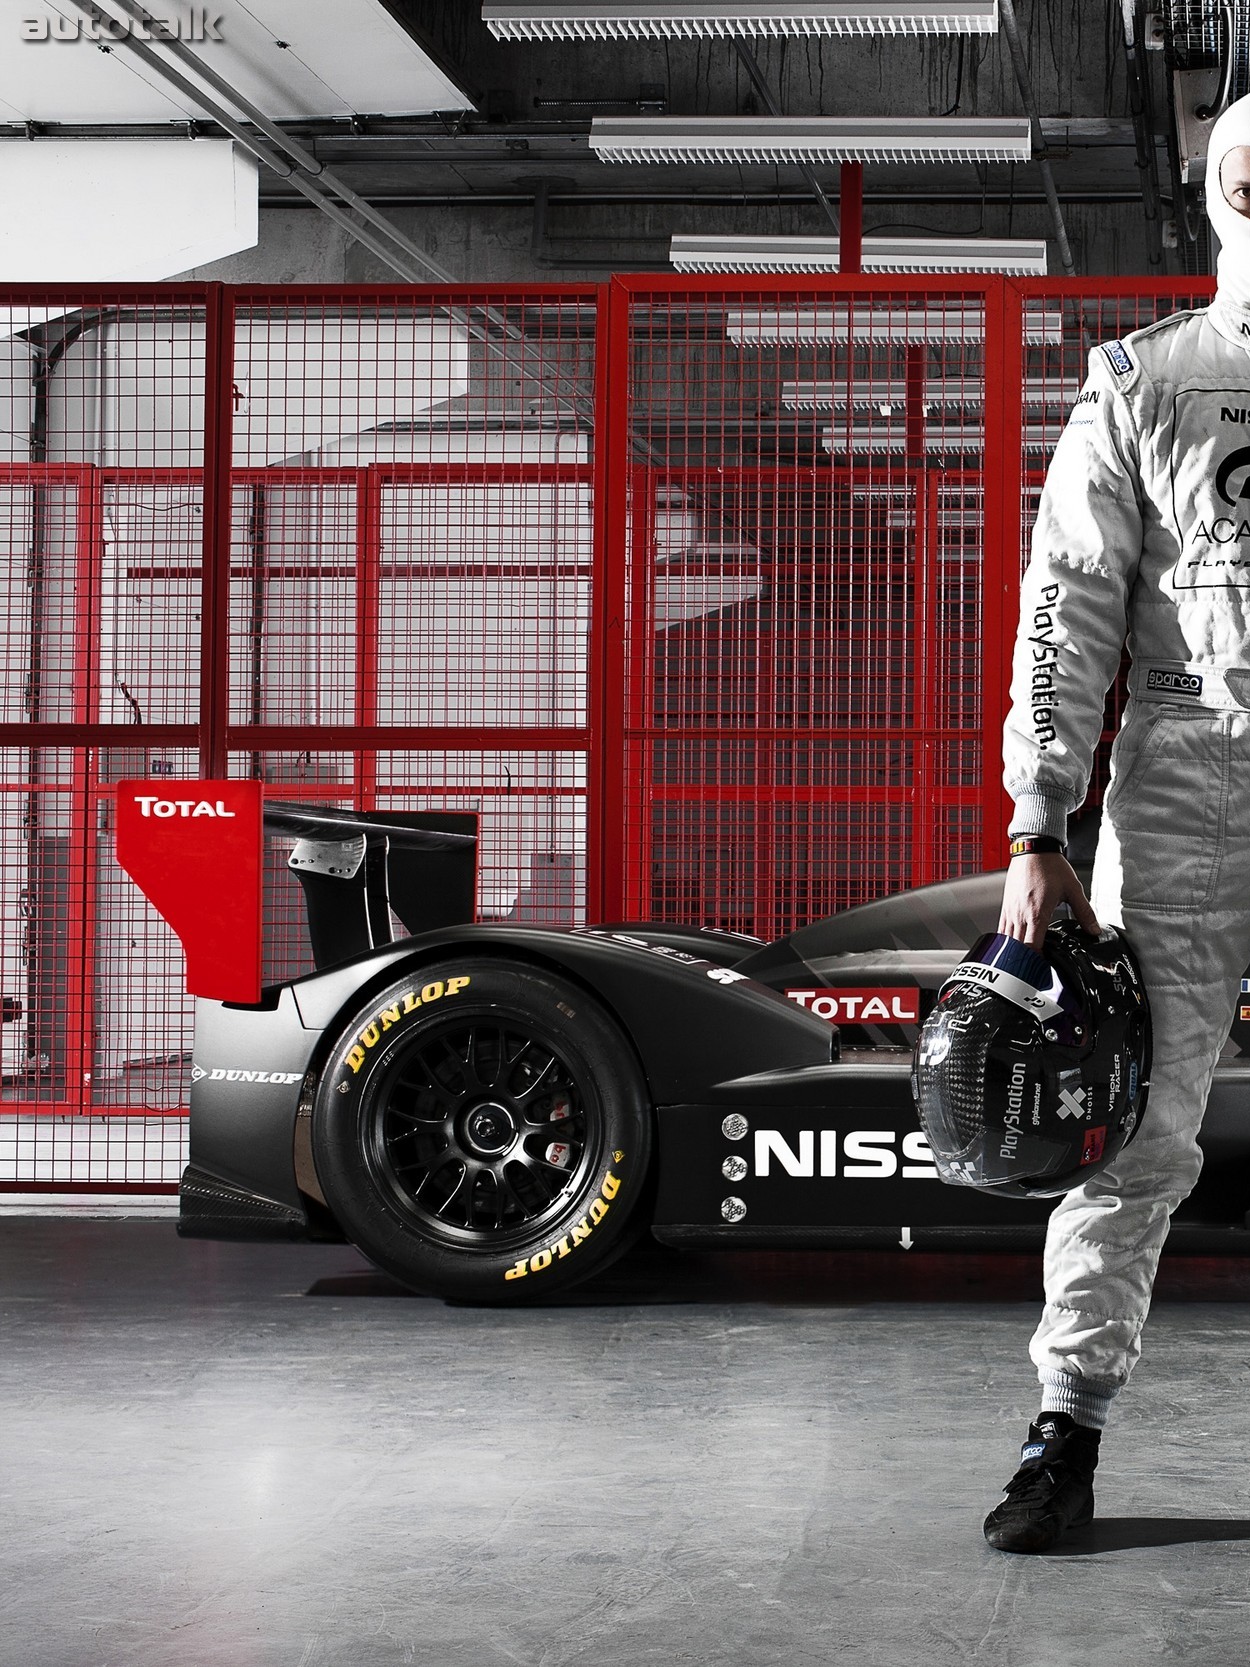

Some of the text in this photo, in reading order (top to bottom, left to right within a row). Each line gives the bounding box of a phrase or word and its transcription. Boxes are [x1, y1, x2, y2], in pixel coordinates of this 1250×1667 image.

[1148, 671, 1200, 689] sparco
[134, 796, 236, 818] TOTAL
[787, 991, 915, 1020] TOTAL
[344, 976, 471, 1074] DUNLOP
[207, 1069, 304, 1085] DUNLOP
[1108, 1073, 1116, 1112] VISION
[1000, 1062, 1027, 1160] PlayStation
[504, 1170, 621, 1280] DUNLOP
